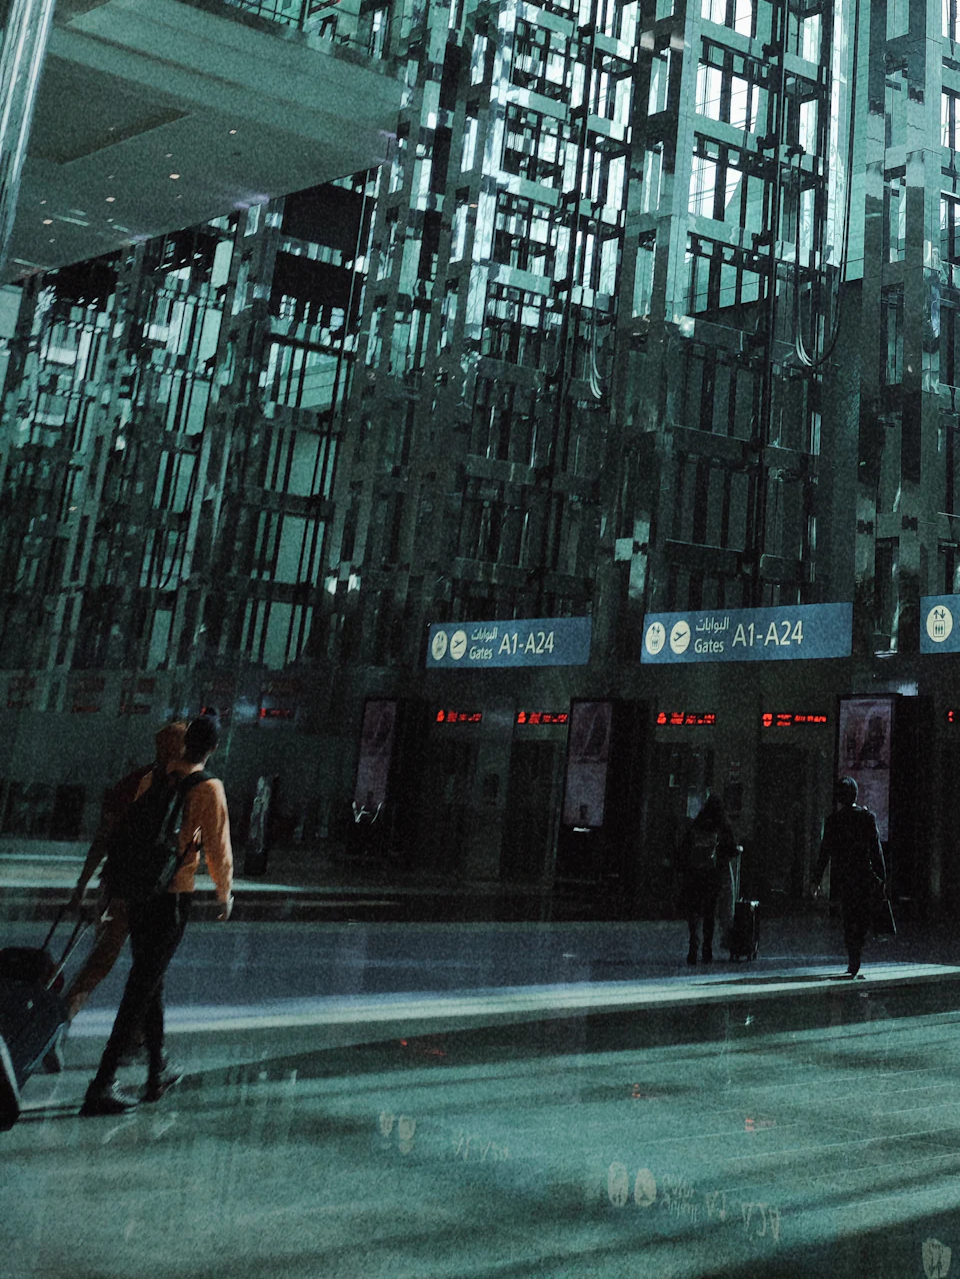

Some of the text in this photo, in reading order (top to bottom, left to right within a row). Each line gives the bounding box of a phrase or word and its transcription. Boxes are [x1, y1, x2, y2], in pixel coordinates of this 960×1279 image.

[694, 620, 804, 654] Gates A1-A24
[695, 617, 729, 634] البوابات
[469, 631, 555, 660] Gates A1-A24
